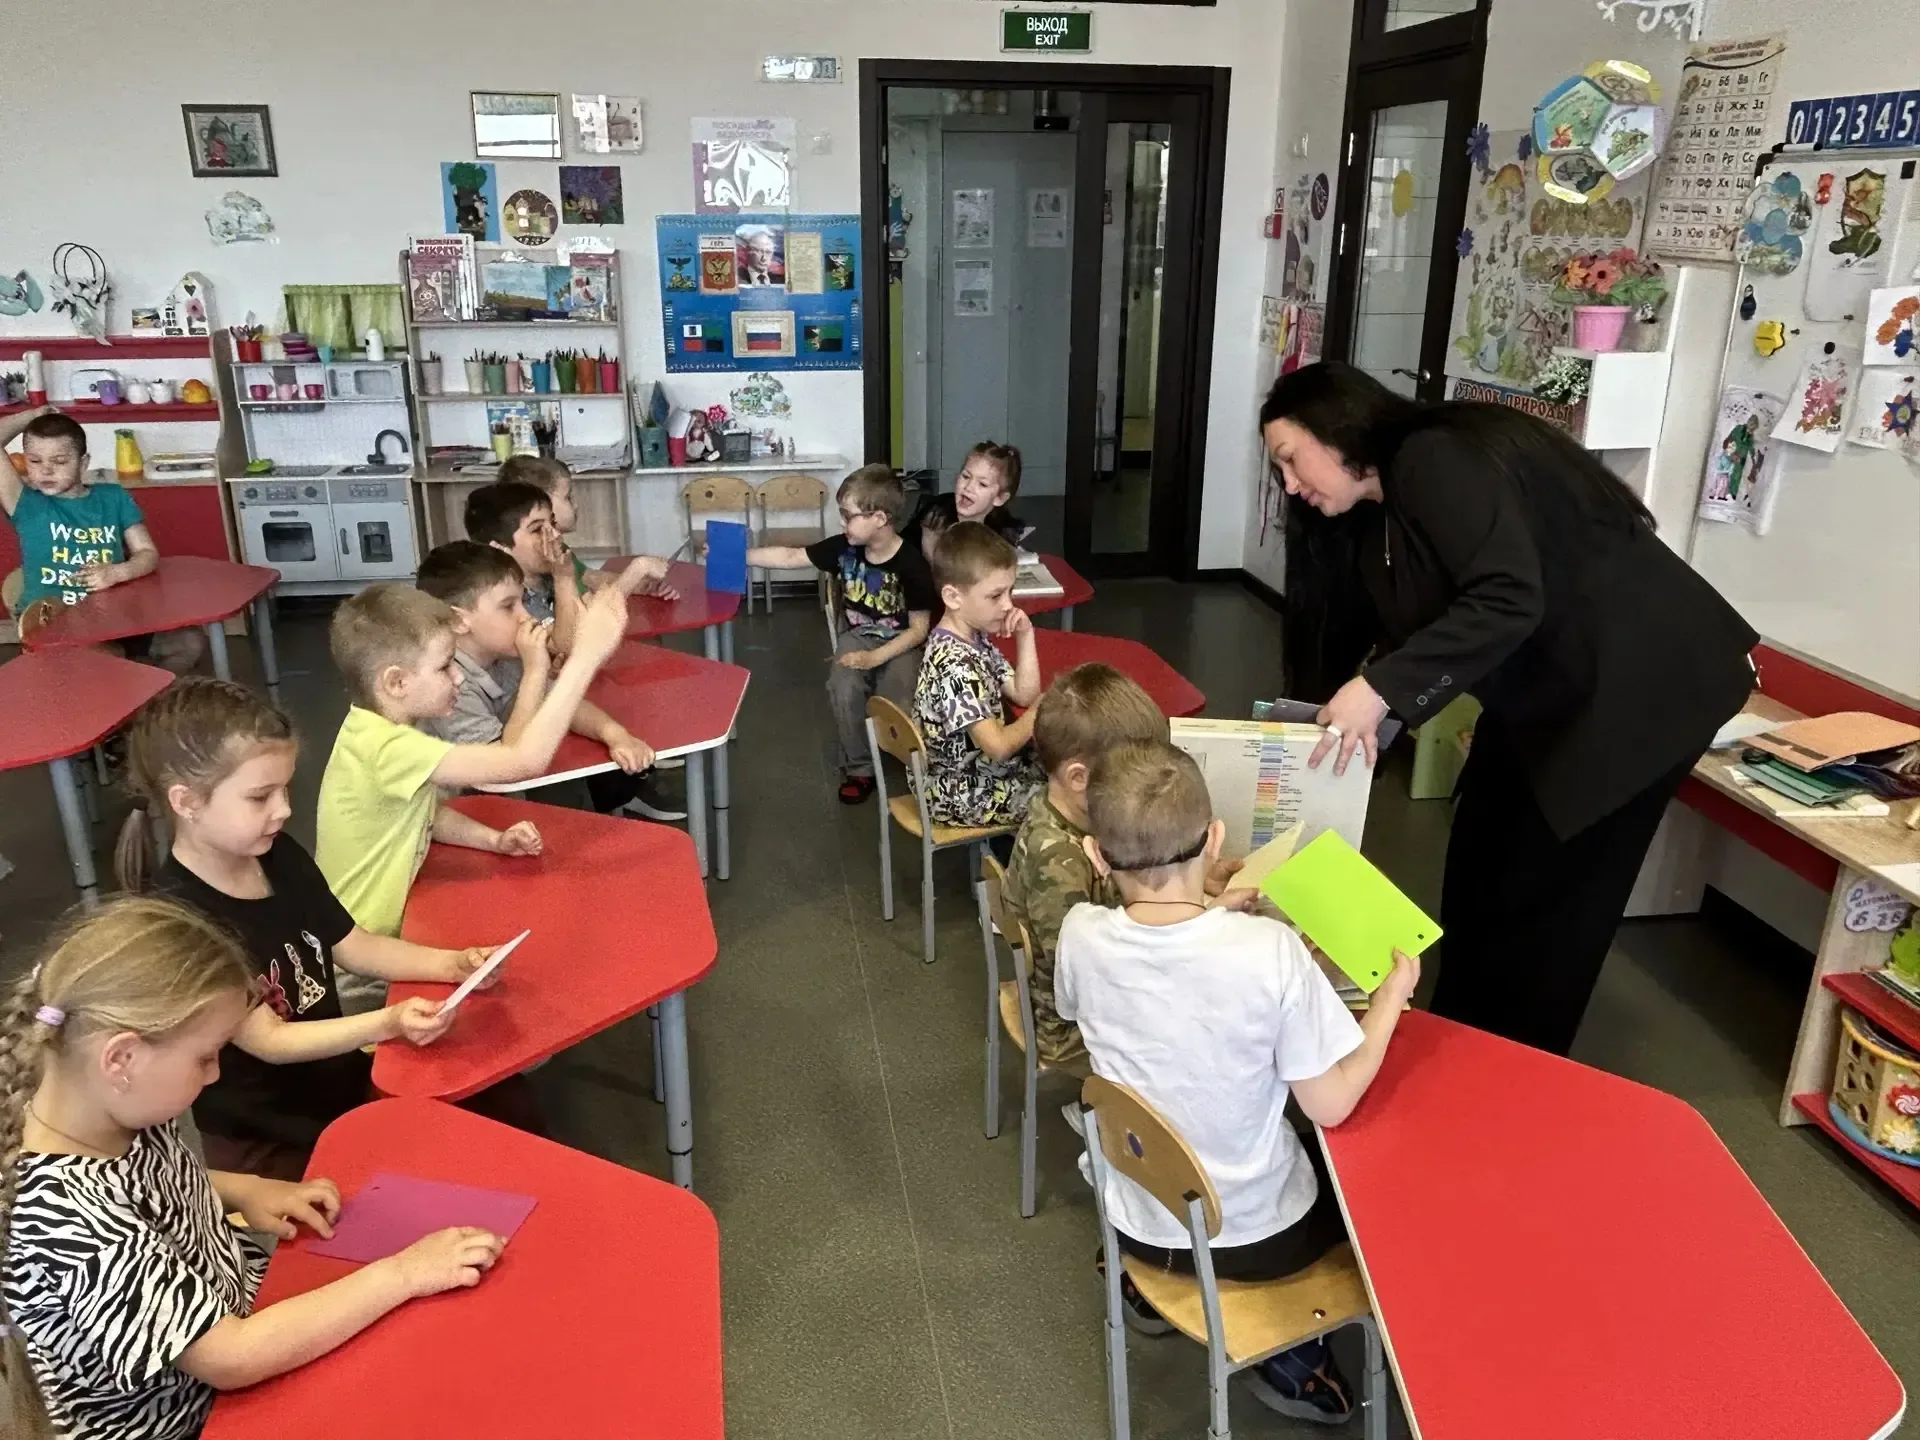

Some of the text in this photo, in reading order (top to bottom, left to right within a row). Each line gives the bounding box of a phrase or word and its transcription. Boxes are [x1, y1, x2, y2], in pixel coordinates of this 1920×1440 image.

[1026, 17, 1068, 34] ВЫХОД
[1035, 34, 1060, 46] EXIT
[1791, 100, 1916, 144] 0 1 2 3 4 5
[1504, 394, 1572, 421] ПРИРОДЫ
[50, 522, 117, 544] WORK
